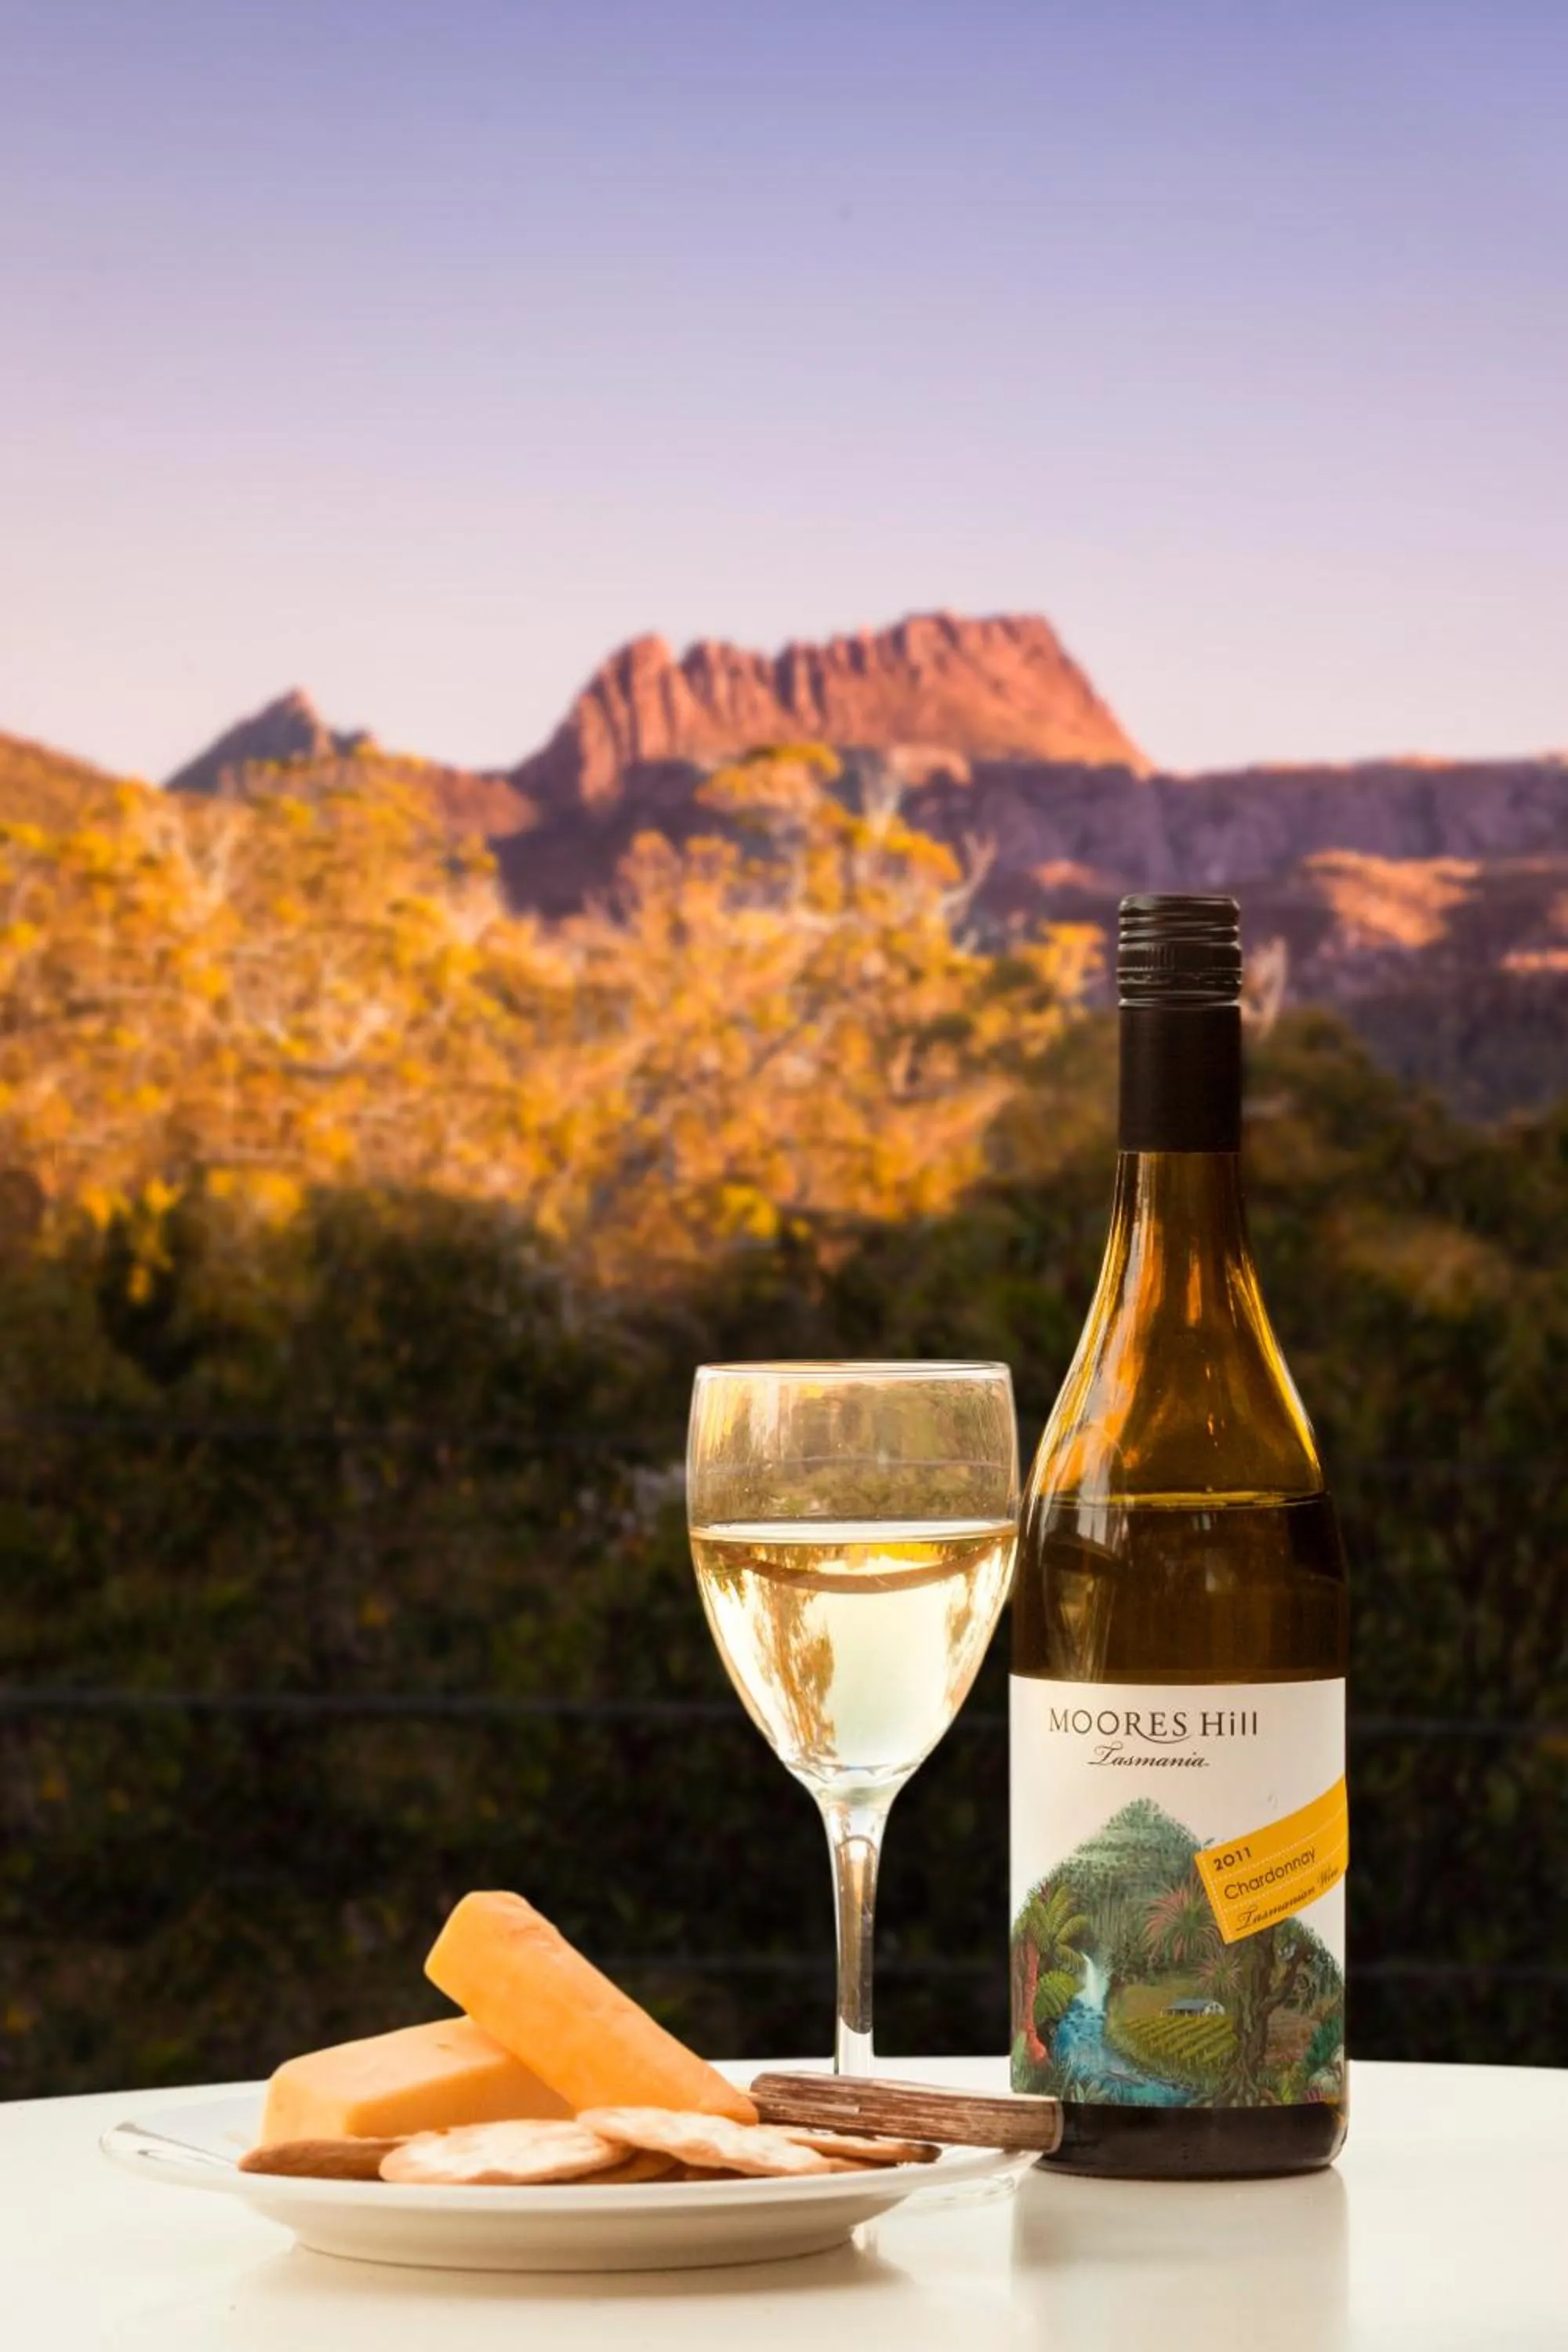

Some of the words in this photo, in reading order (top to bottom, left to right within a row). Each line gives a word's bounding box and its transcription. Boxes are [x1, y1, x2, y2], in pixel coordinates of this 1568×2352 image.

[1049, 1708, 1191, 1744] MOORES
[1201, 1710, 1258, 1737] Hill
[1087, 1741, 1210, 1768] Tasmania
[1213, 1846, 1252, 1871] 2011
[1224, 1846, 1316, 1900] Chardonnay
